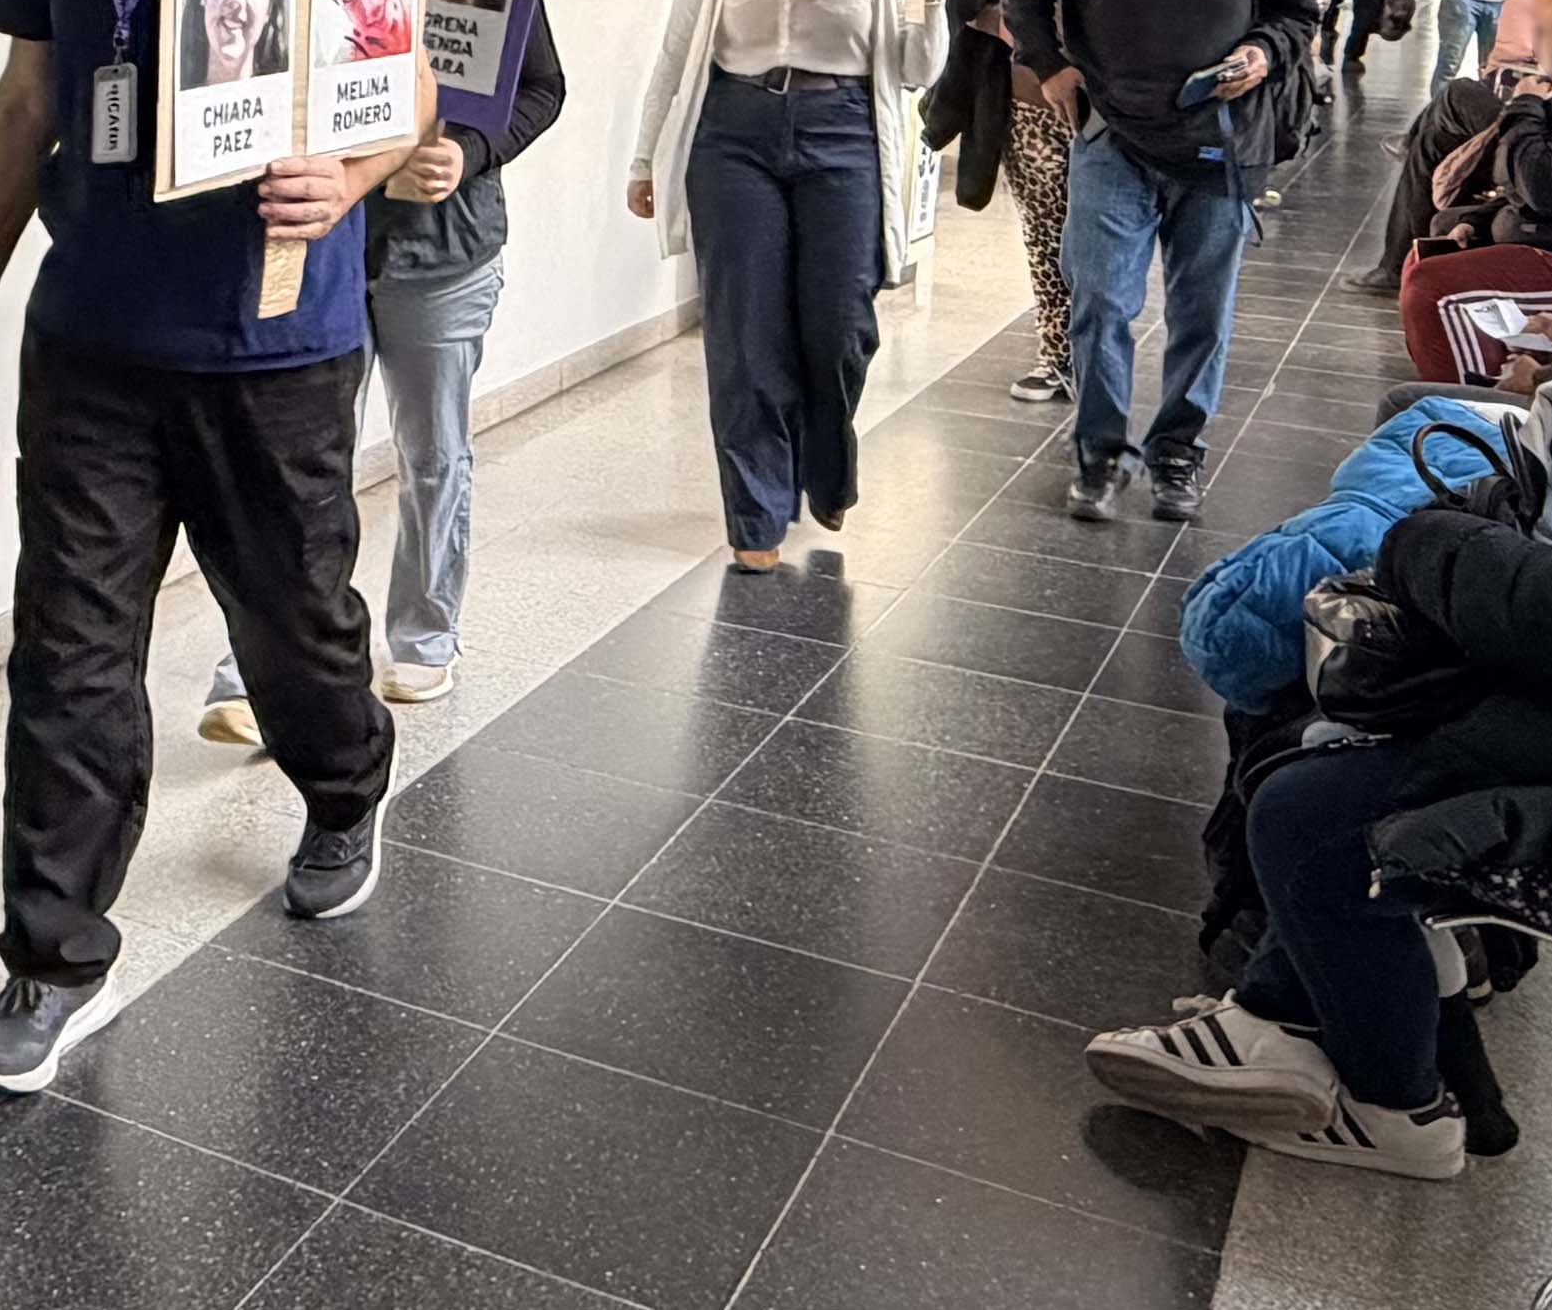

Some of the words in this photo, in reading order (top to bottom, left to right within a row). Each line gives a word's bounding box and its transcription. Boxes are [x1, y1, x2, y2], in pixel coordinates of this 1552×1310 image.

[429, 56, 465, 78] ARA
[336, 75, 390, 104] MELINA
[203, 96, 264, 129] CHIARA
[332, 101, 392, 133] ROMERO
[212, 128, 253, 159] PAEZ
